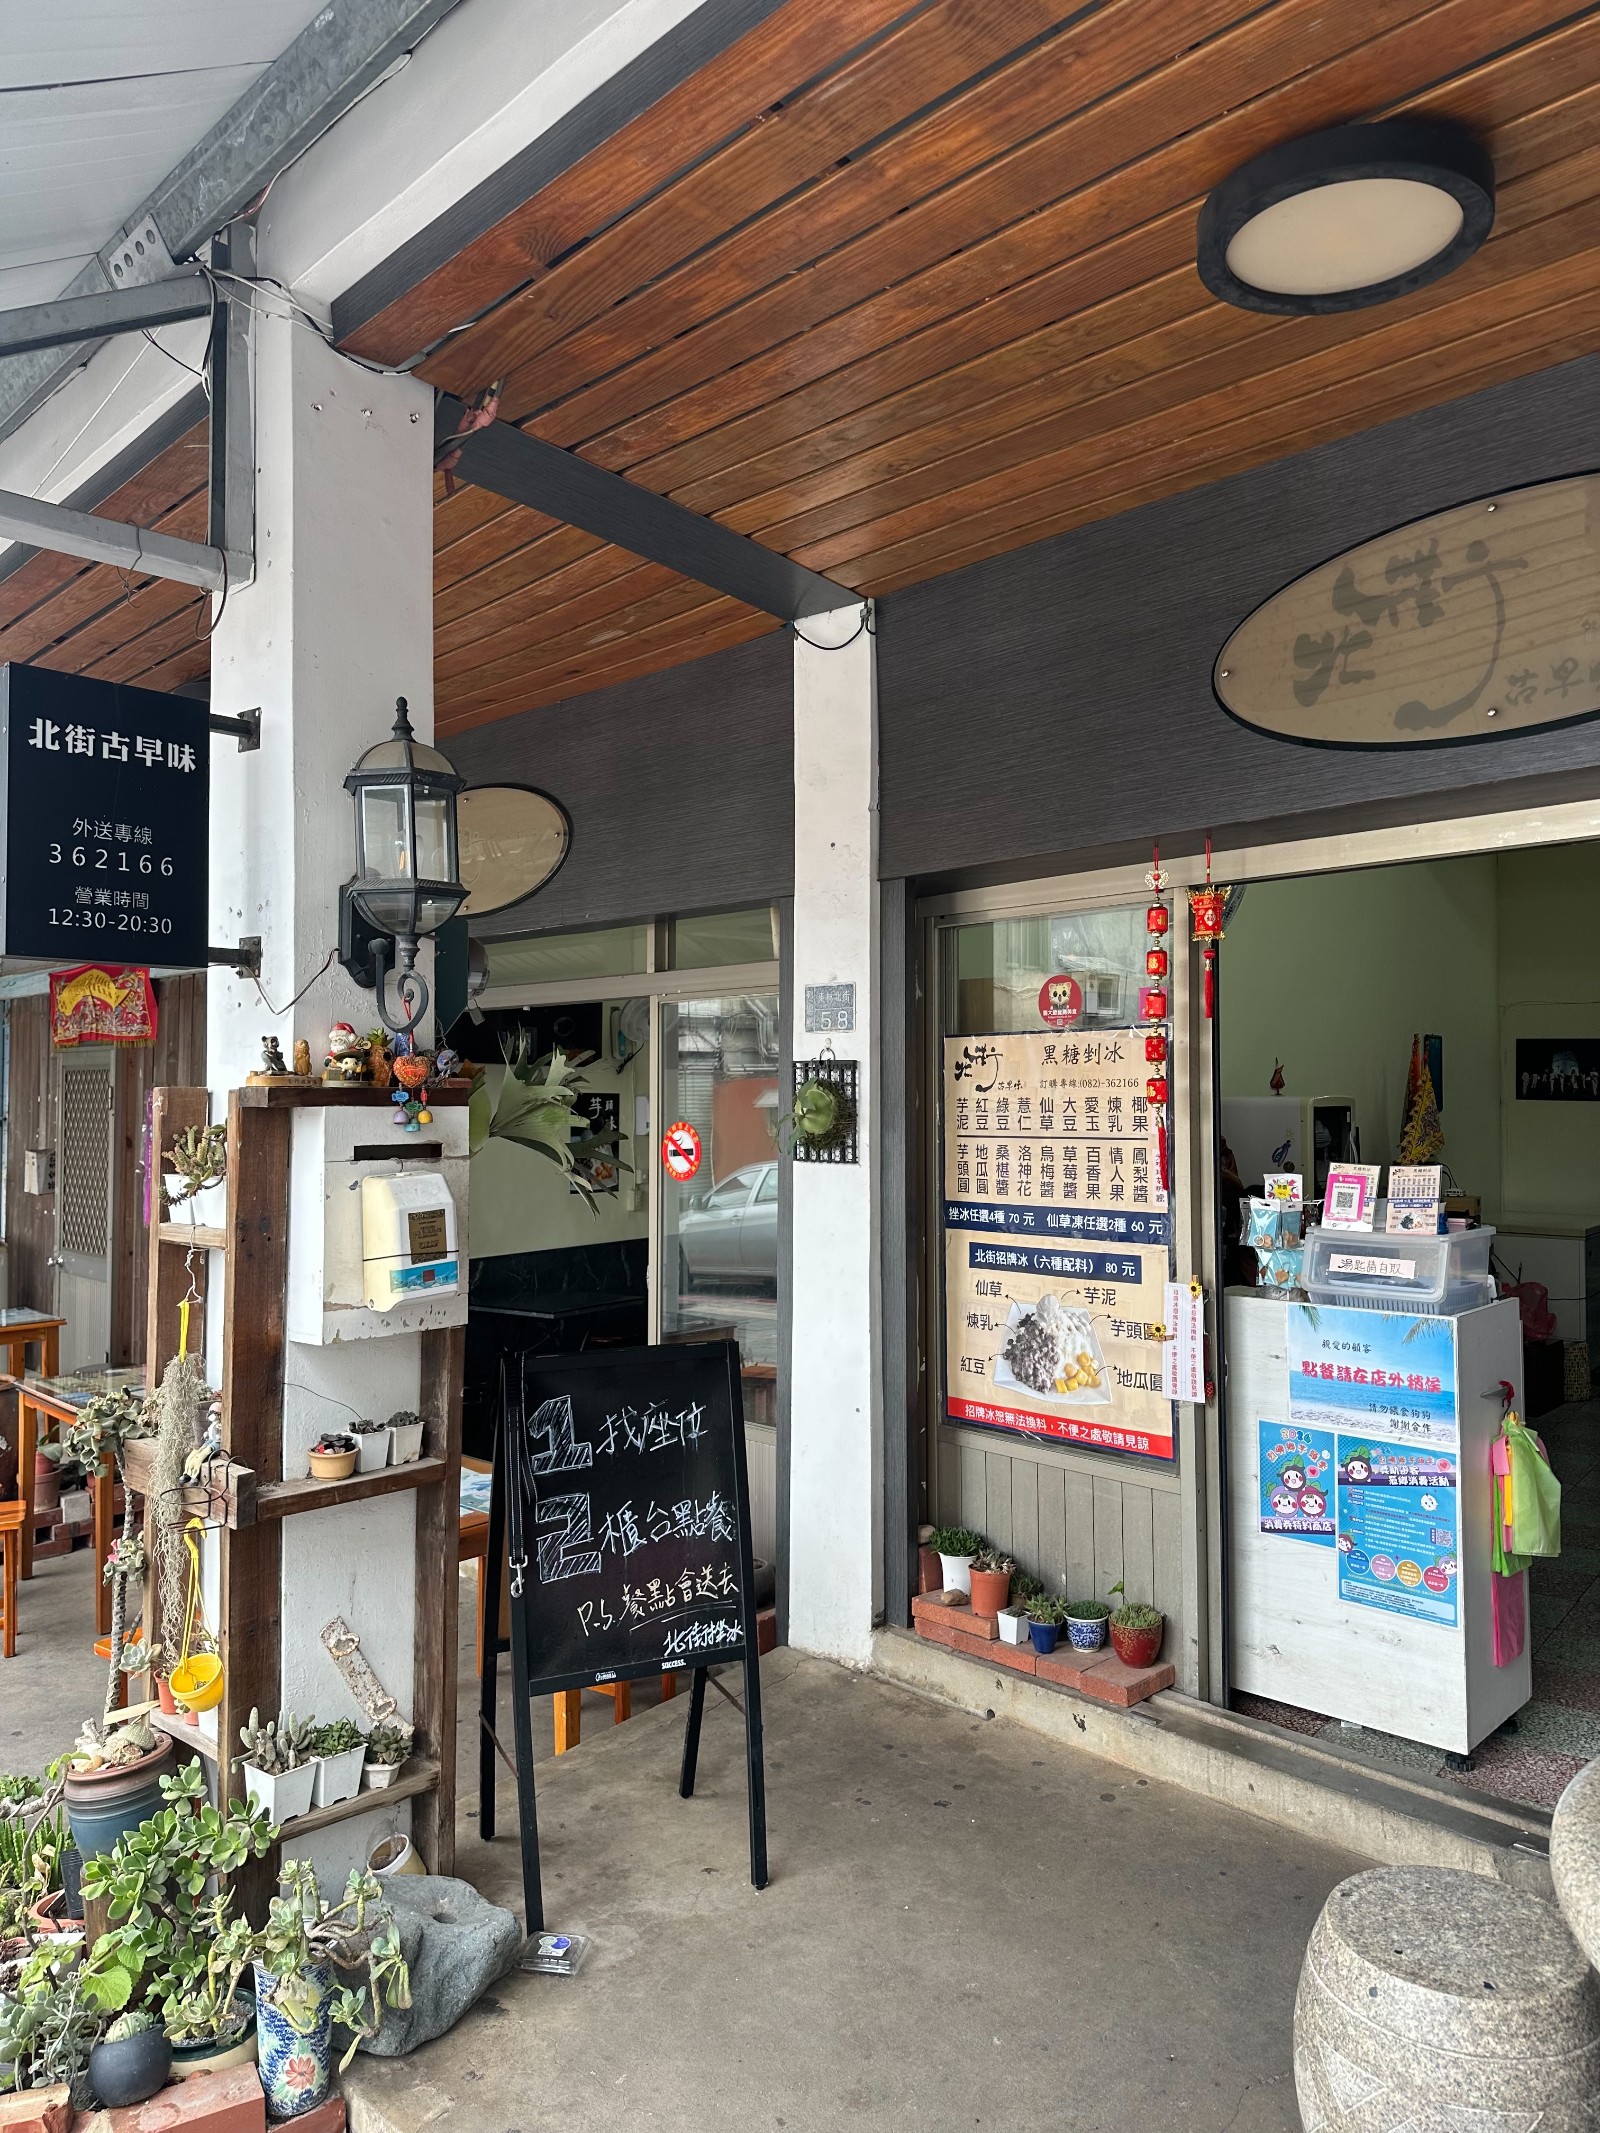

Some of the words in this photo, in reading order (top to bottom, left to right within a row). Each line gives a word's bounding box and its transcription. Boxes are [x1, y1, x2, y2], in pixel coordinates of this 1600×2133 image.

[28, 717, 196, 773] 北街古早味
[72, 817, 153, 845] 外送專線
[49, 843, 173, 877] 362166
[74, 886, 149, 910] 營業時間
[48, 908, 172, 935] 12:30-20:30
[820, 1010, 848, 1030] 58
[1041, 1041, 1125, 1066] 黑糖剉冰
[956, 1097, 969, 1131] 芋泥
[975, 1097, 988, 1131] 紅豆
[996, 1097, 1010, 1131] 綠豆
[1017, 1097, 1032, 1131] 薏仁
[1039, 1097, 1054, 1131] 仙草
[1062, 1097, 1077, 1132] 大豆
[1084, 1097, 1100, 1132] 愛玉
[1107, 1096, 1123, 1132] 煉乳
[1131, 1096, 1148, 1132] 椰果
[957, 1144, 970, 1194] 芋頭圓
[975, 1144, 989, 1195] 地瓜圓
[996, 1144, 1010, 1196] 桑椹醬
[1017, 1145, 1032, 1197] 洛神花
[1040, 1145, 1054, 1199] 烏梅醬
[1062, 1146, 1078, 1200] 草莓醬
[1086, 1146, 1101, 1201] 百香果
[1109, 1146, 1124, 1202] 情人果
[1132, 1147, 1148, 1203] 鳳梨醬
[948, 1207, 1006, 1224] 挫冰任選4種
[1009, 1213, 1020, 1224] 70
[1023, 1212, 1035, 1226] 元
[1047, 1213, 1127, 1233] 仙草凍任選2種
[1131, 1221, 1144, 1232] 60
[1149, 1220, 1163, 1235] 元
[1105, 1262, 1118, 1274] 80
[1122, 1261, 1136, 1277] 元
[1337, 1258, 1404, 1275] 湯匙請自取
[975, 1279, 1003, 1297] 仙草
[1084, 1286, 1117, 1306] 芋泥
[966, 1312, 994, 1331] 煉乳
[1321, 1338, 1372, 1354] 親愛的顧客
[960, 1355, 986, 1375] 紅豆
[1116, 1368, 1163, 1391] 地瓜圓
[528, 1394, 593, 1476] 1
[596, 1399, 708, 1455] 找座位
[1389, 1417, 1432, 1433] 謝謝合作
[535, 1492, 602, 1584] 2
[599, 1490, 737, 1557] 櫃台點餐
